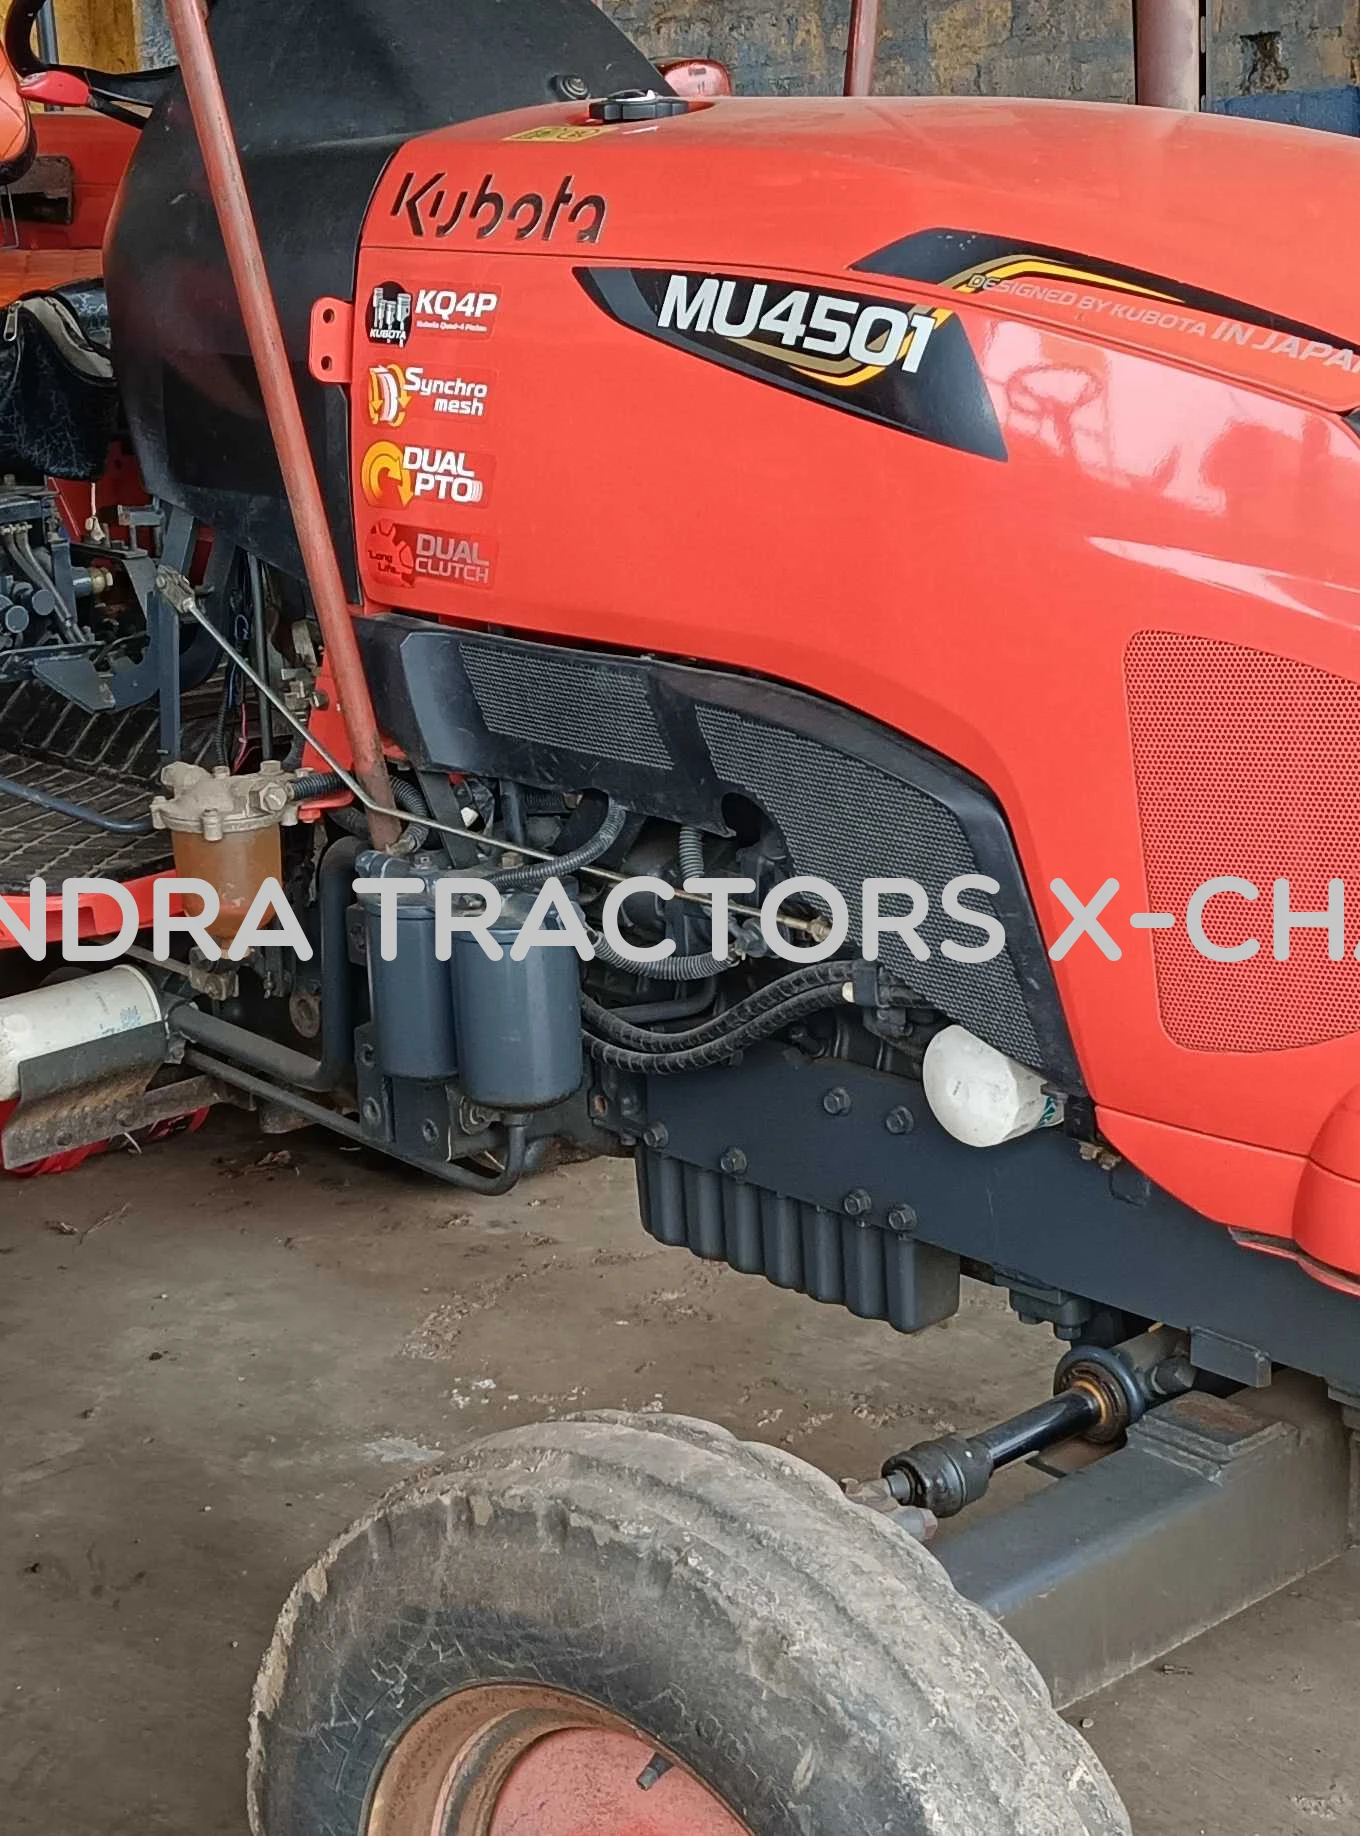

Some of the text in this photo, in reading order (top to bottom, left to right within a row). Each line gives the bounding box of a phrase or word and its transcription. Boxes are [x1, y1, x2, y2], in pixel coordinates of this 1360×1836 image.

[390, 171, 608, 244] Kubota
[414, 288, 498, 321] KQ4P
[967, 274, 1075, 306] DESIGNED
[1077, 295, 1113, 313] BY
[1110, 303, 1207, 337] KUBOTA
[1211, 320, 1256, 346] IN
[369, 328, 407, 341] KUBOTA
[656, 273, 937, 374] MU4501
[402, 366, 488, 400] Synchro
[433, 397, 485, 417] mesh
[401, 446, 475, 479] DUAL
[414, 473, 474, 503] PTO
[415, 532, 490, 566] DUAL
[415, 557, 489, 584] CLUTCH
